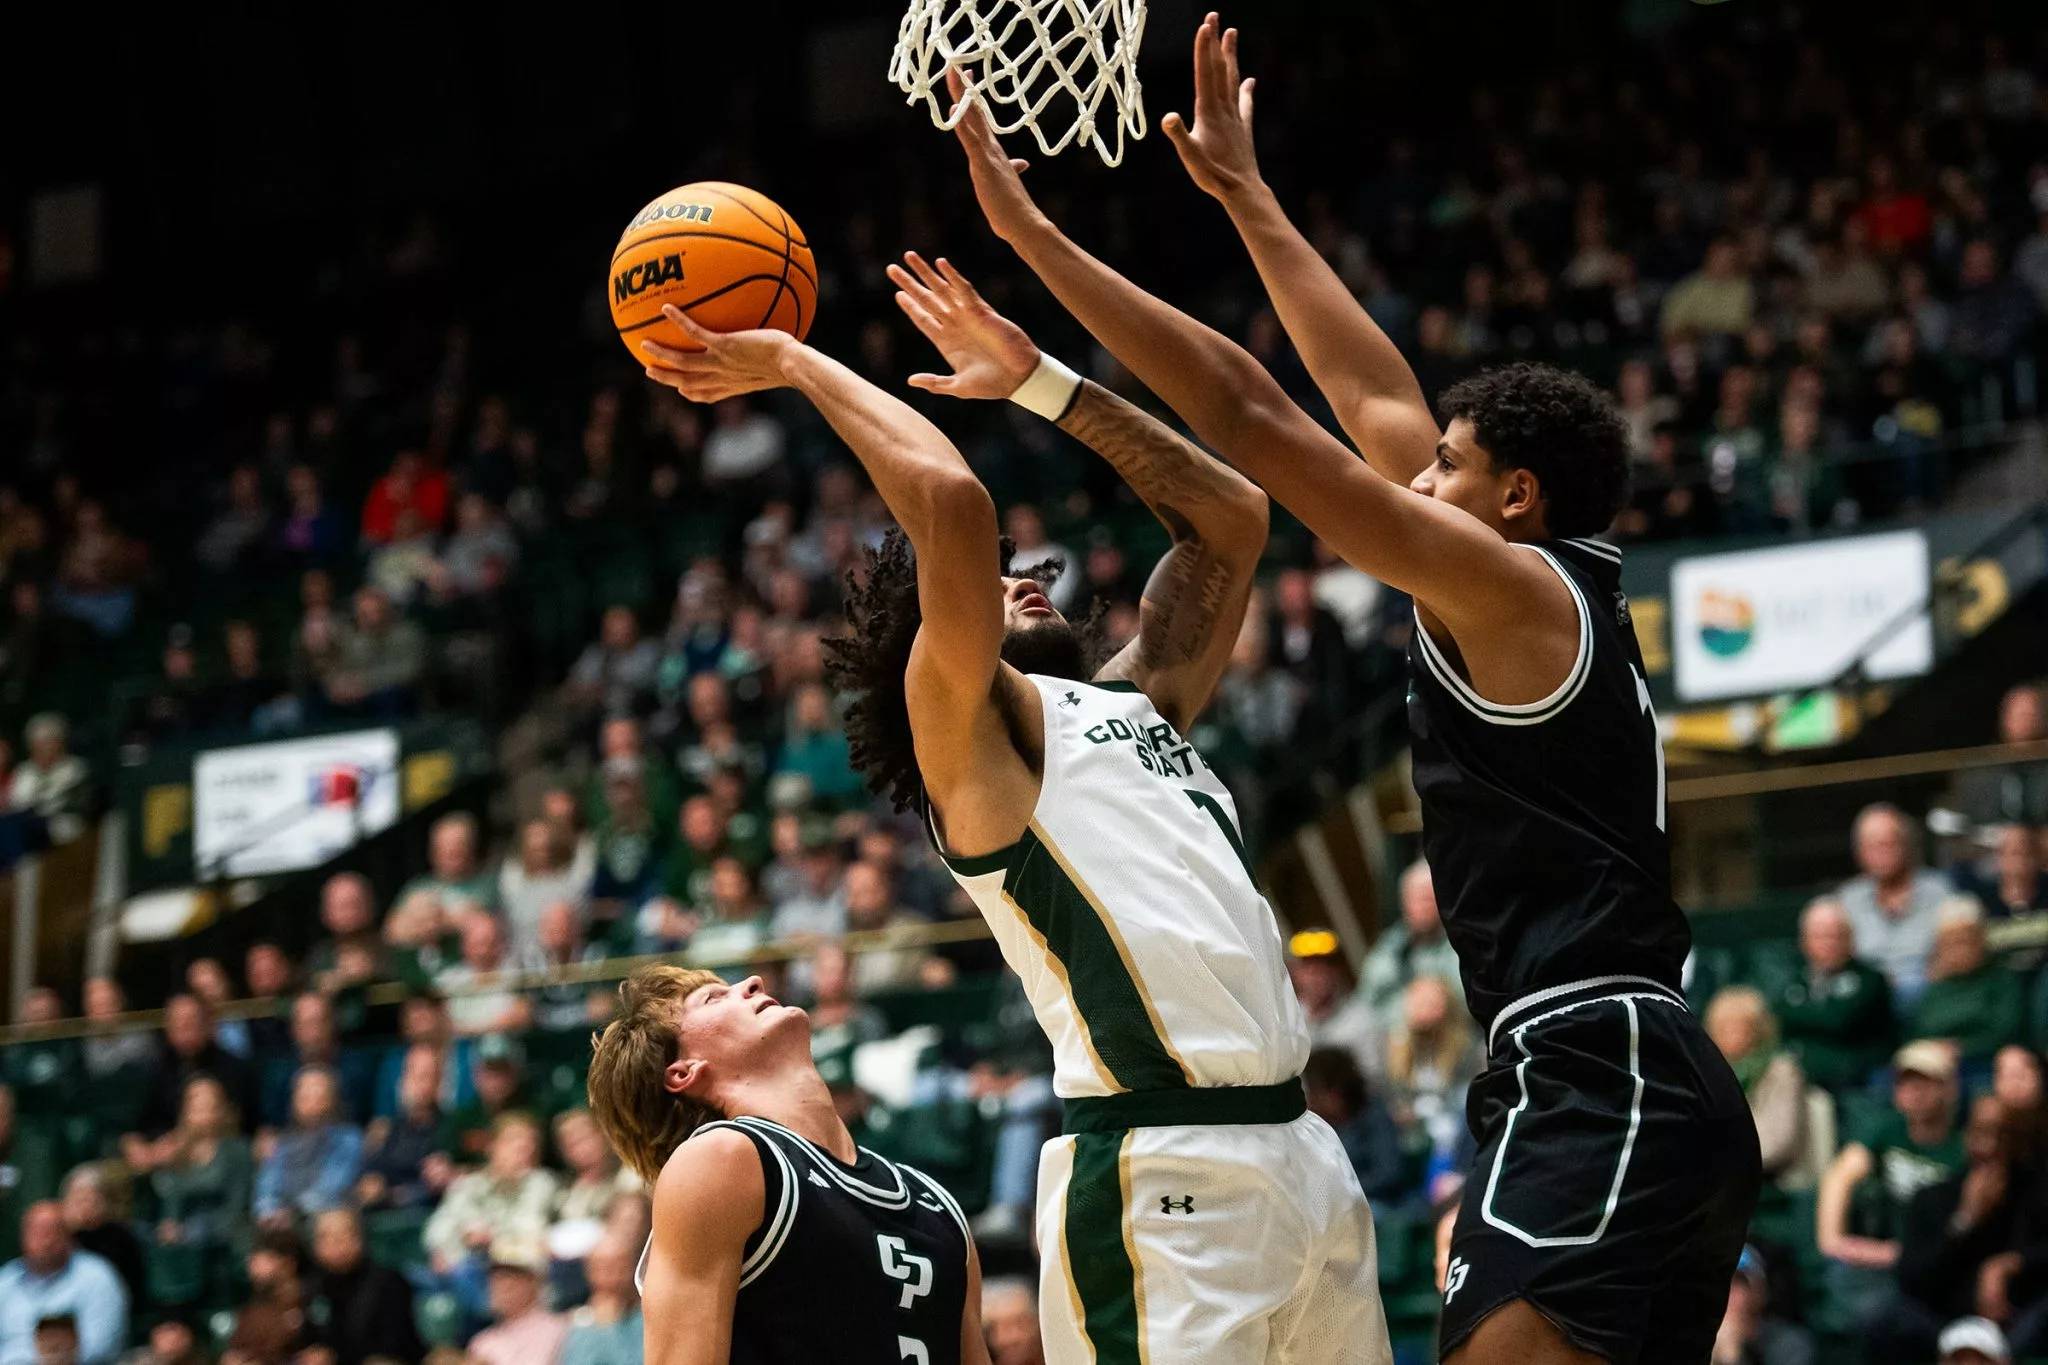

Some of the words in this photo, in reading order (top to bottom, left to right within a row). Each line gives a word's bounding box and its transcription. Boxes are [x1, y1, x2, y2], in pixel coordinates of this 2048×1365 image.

[614, 255, 685, 305] NCAA
[1200, 561, 1230, 613] WAY
[1083, 718, 1184, 752] COLOR
[876, 1234, 934, 1310] CP
